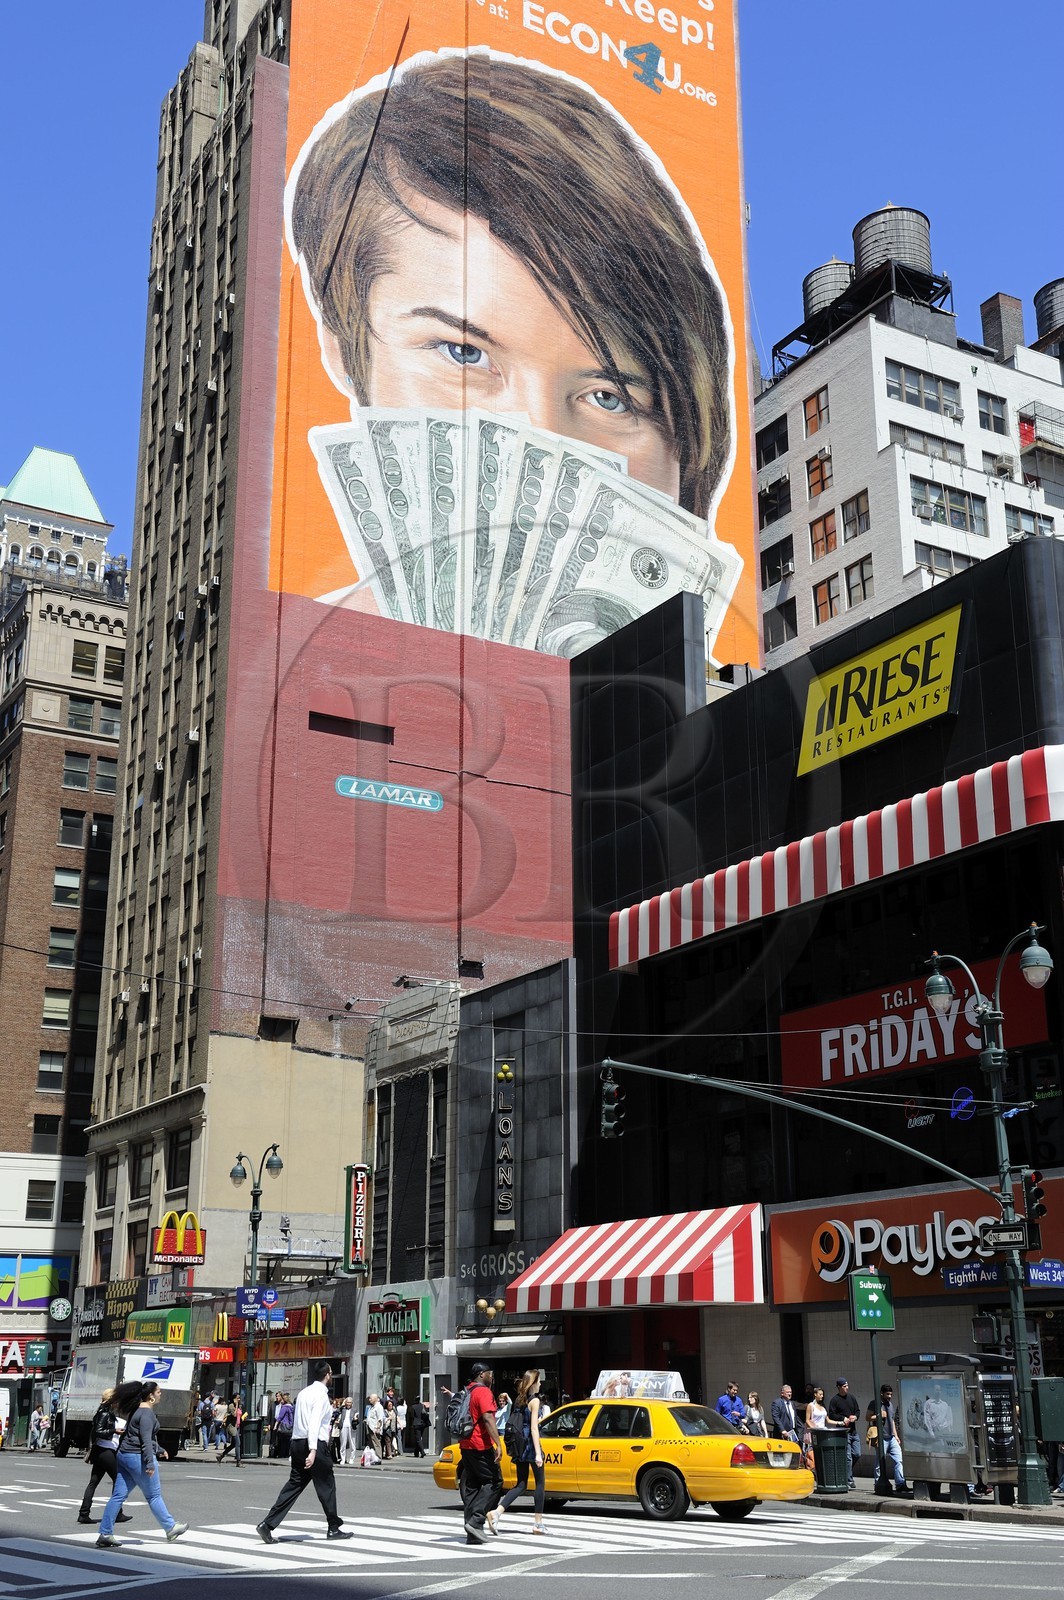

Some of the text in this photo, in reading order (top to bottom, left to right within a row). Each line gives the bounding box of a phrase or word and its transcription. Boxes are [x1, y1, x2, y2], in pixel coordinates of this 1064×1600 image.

[489, 4, 508, 19] at:
[812, 688, 941, 759] RESTAURANTS
[348, 781, 432, 806] LAMAR
[882, 987, 918, 1010] T.G.I.
[907, 1114, 935, 1128] LIGHT
[498, 1091, 514, 1214] LOANS
[353, 1170, 366, 1262] PIZZERIA
[988, 1232, 1021, 1242] ONE WAY
[154, 1254, 204, 1263] McDonald's
[480, 1250, 526, 1277] GROSS
[948, 1270, 978, 1286] Eighth
[980, 1270, 998, 1281] Ave
[1029, 1268, 1051, 1281] West
[859, 1281, 886, 1291] Subway
[106, 1300, 134, 1318] Hippo
[367, 1309, 419, 1334] FAMIGLIA
[78, 1325, 100, 1338] COFFEE
[169, 1325, 183, 1338] NY
[273, 1341, 289, 1356] 24
[296, 1338, 325, 1357] HOURS
[632, 1381, 666, 1390] DKNY
[543, 1453, 563, 1465] AXI
